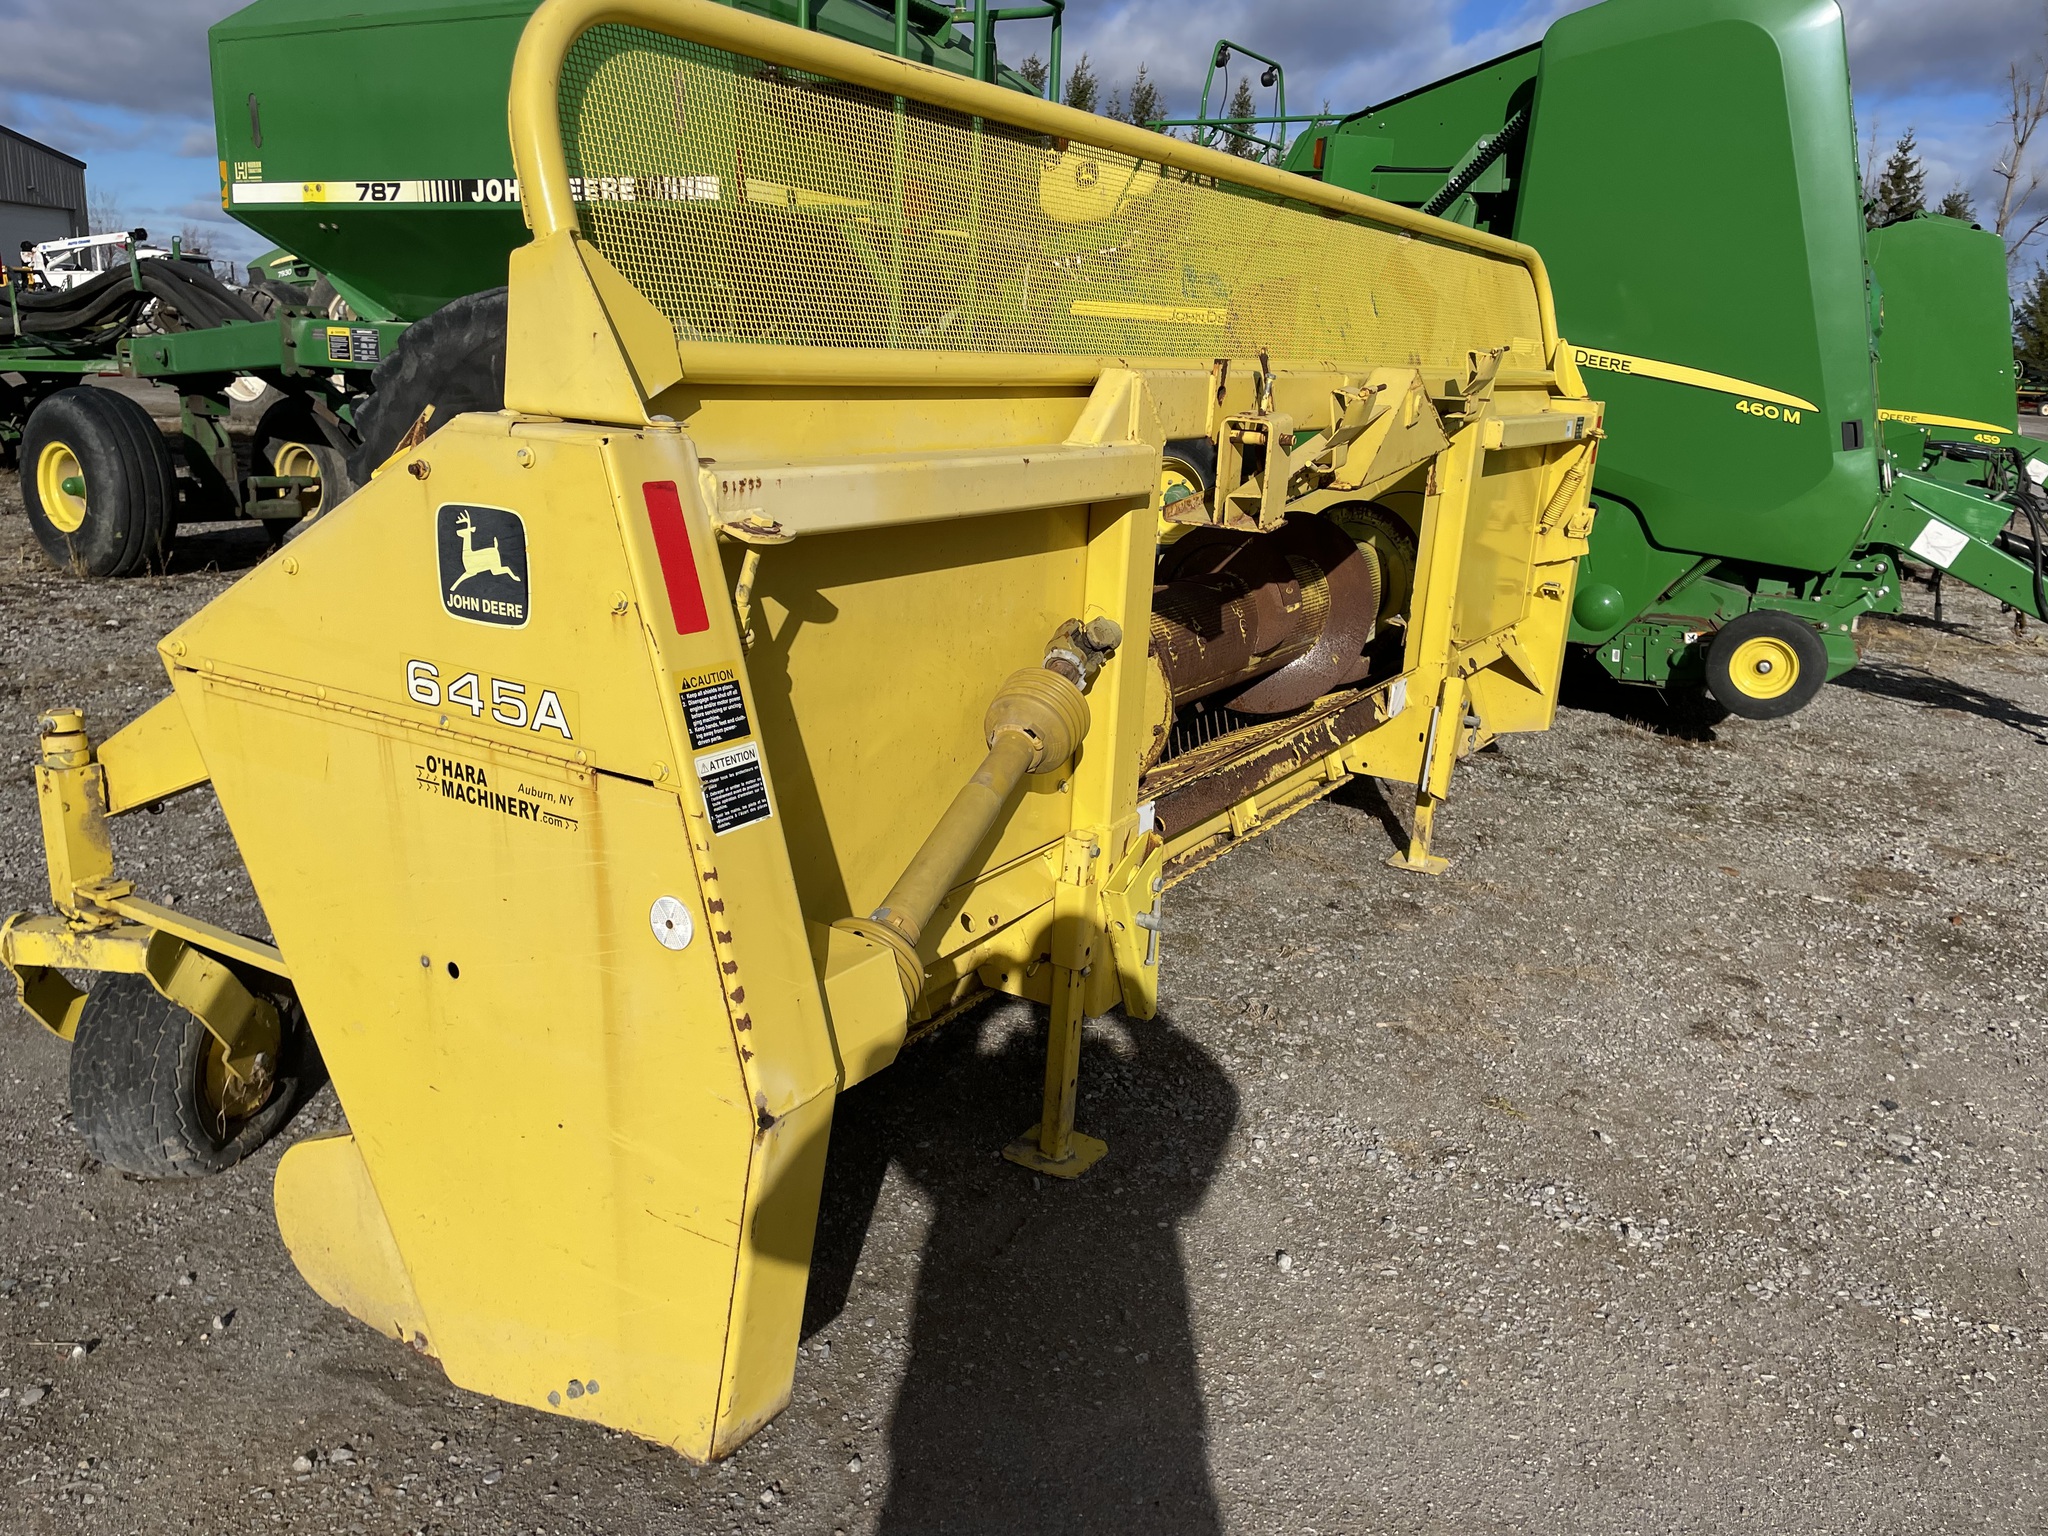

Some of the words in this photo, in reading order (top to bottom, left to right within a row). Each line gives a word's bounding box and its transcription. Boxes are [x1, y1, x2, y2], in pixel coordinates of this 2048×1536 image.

[355, 183, 401, 201] 787
[471, 180, 521, 202] JOH
[569, 177, 635, 201] EERE
[1575, 350, 1632, 371] DEERE
[1735, 400, 1780, 419] 460
[1783, 409, 1802, 424] M
[1880, 411, 1918, 423] DEERE
[1974, 433, 2001, 445] 459
[447, 594, 479, 612] JOHN
[482, 599, 523, 619] DEERE
[690, 669, 733, 687] CAUTION
[406, 659, 574, 740] 645A
[426, 755, 488, 787] O'HARA
[710, 749, 755, 770] ATTENTION
[441, 779, 540, 822] MACHINERY
[540, 813, 563, 828] .com
[517, 783, 556, 805] Auburn,
[559, 794, 574, 807] NY
